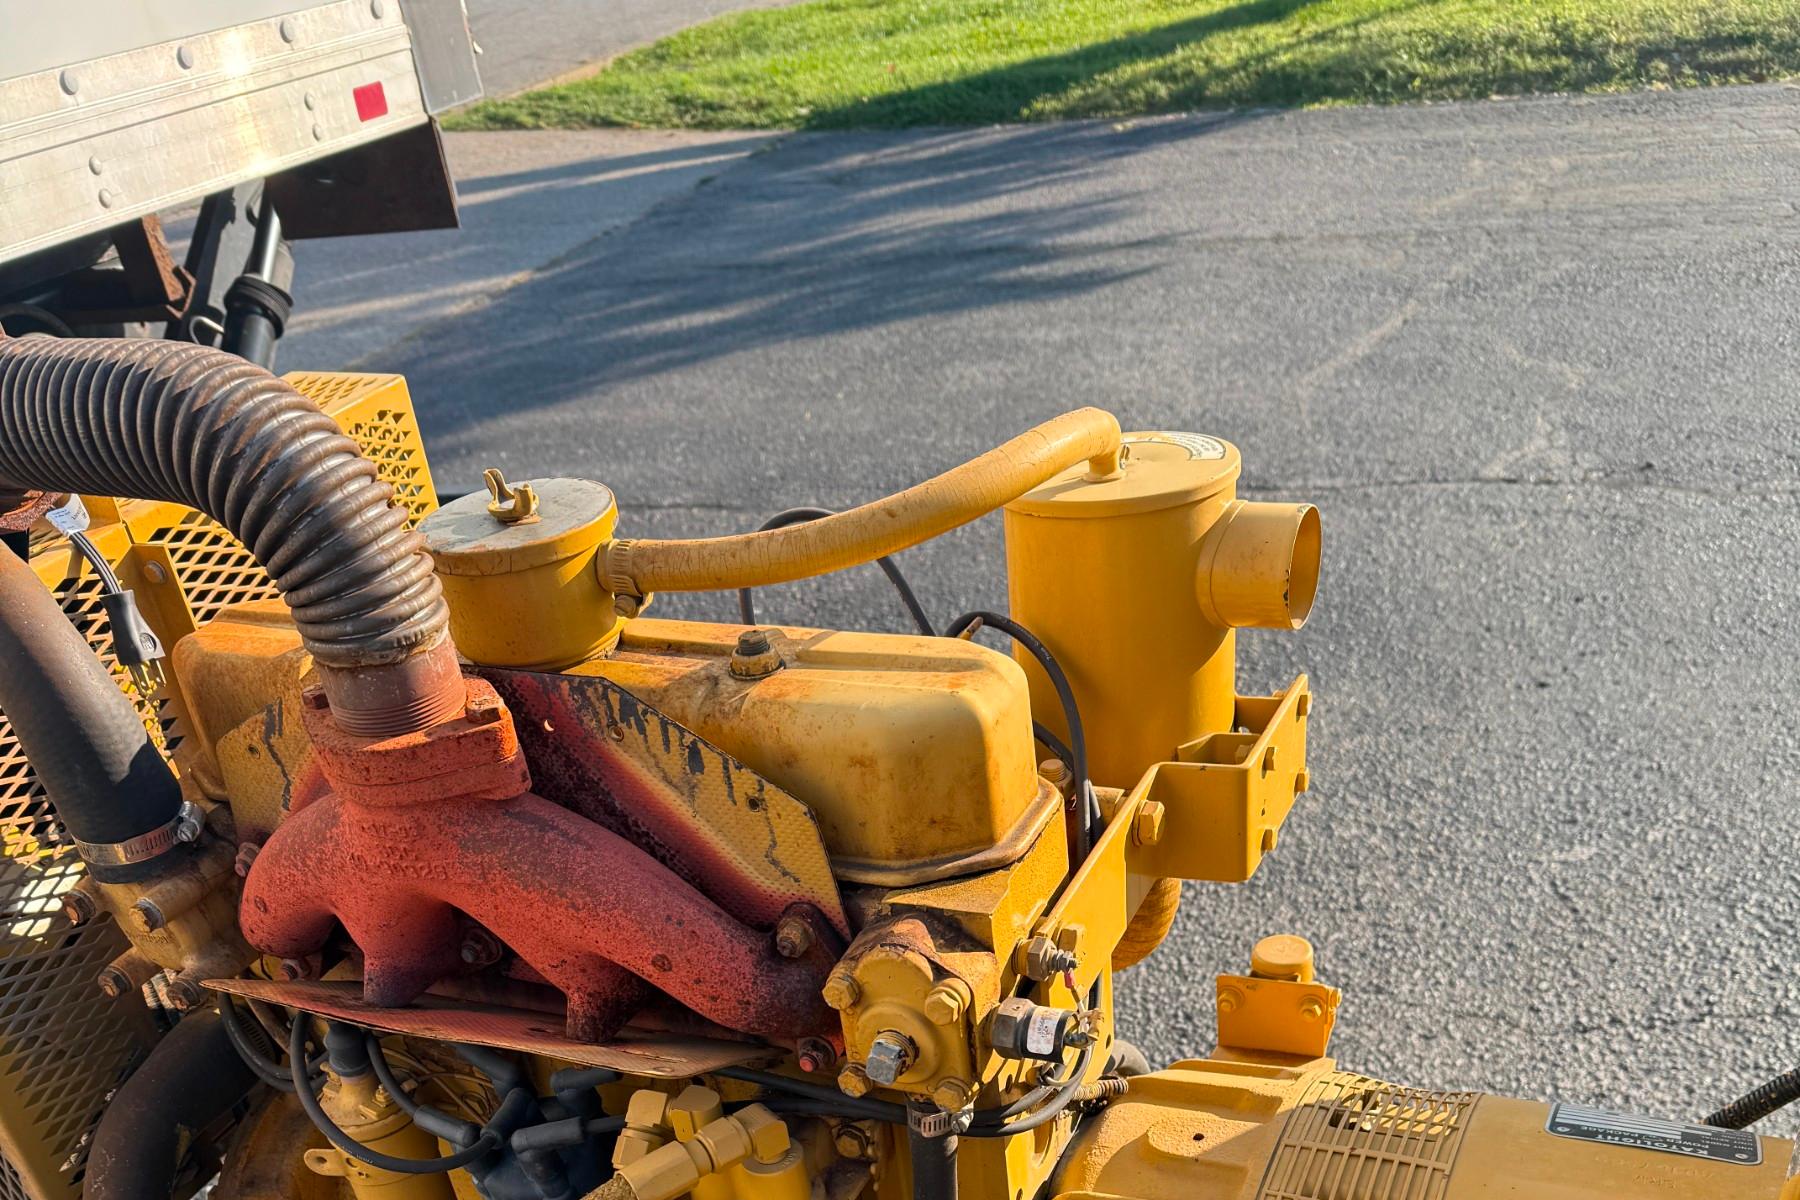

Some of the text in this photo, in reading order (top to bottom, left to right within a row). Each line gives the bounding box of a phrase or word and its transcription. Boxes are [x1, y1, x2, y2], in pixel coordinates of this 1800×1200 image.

[1580, 1125, 1639, 1137] PACKAGE
[1595, 1134, 1708, 1155] KATOLIGHT
[1666, 1138, 1709, 1149] POWER
